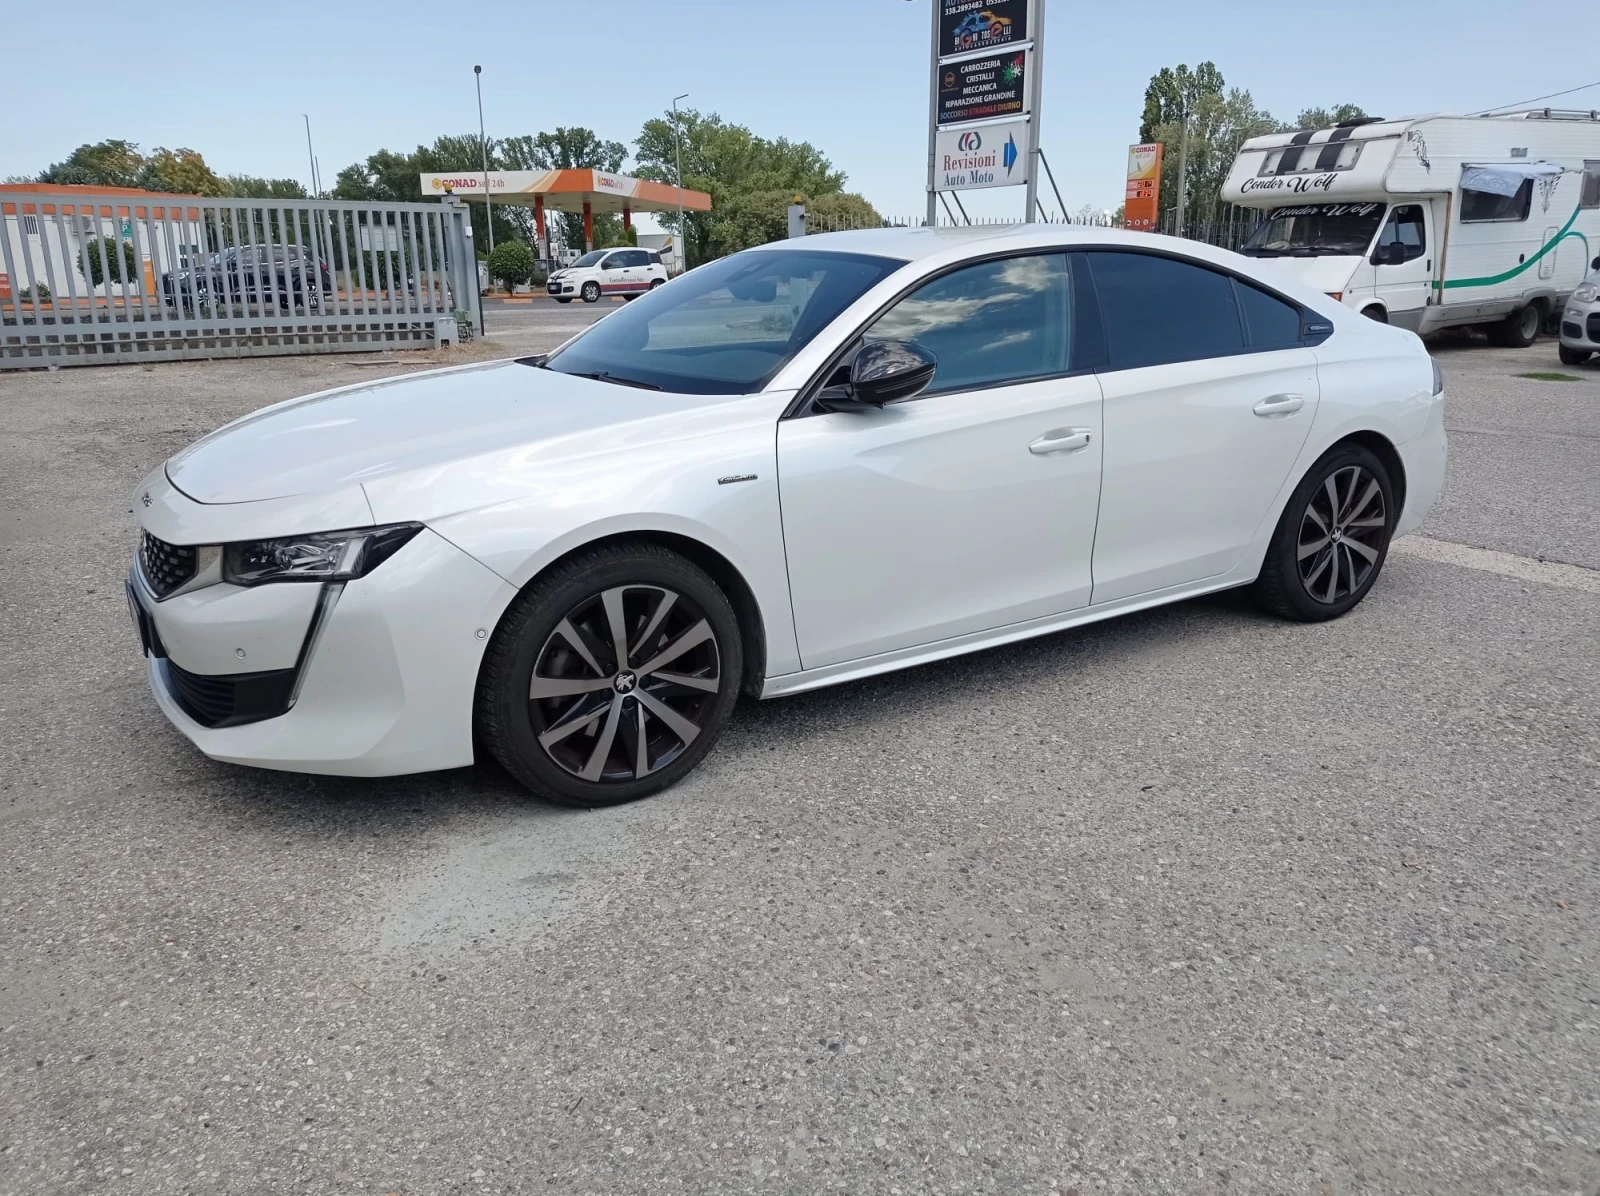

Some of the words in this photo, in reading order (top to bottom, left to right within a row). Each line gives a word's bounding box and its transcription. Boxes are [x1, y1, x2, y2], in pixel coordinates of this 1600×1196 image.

[945, 1, 983, 16] 338.2893482
[960, 60, 1001, 73] CARROZZERIA
[966, 72, 995, 83] CRISTALLI
[963, 83, 997, 95] MECCANICA
[945, 96, 983, 108] RIPARAZIONE
[984, 90, 1016, 102] GRANDINE
[940, 109, 969, 120] SOCCORSO
[970, 106, 997, 117] STRADALE
[997, 101, 1021, 112] DIURNO
[943, 149, 996, 171] Revisioni
[943, 172, 966, 187] Auto
[969, 170, 994, 184] Moto
[1241, 177, 1284, 193] Condor
[1286, 173, 1338, 193] Wolf
[1270, 205, 1319, 220] Condor
[1322, 202, 1378, 217] Wolf
